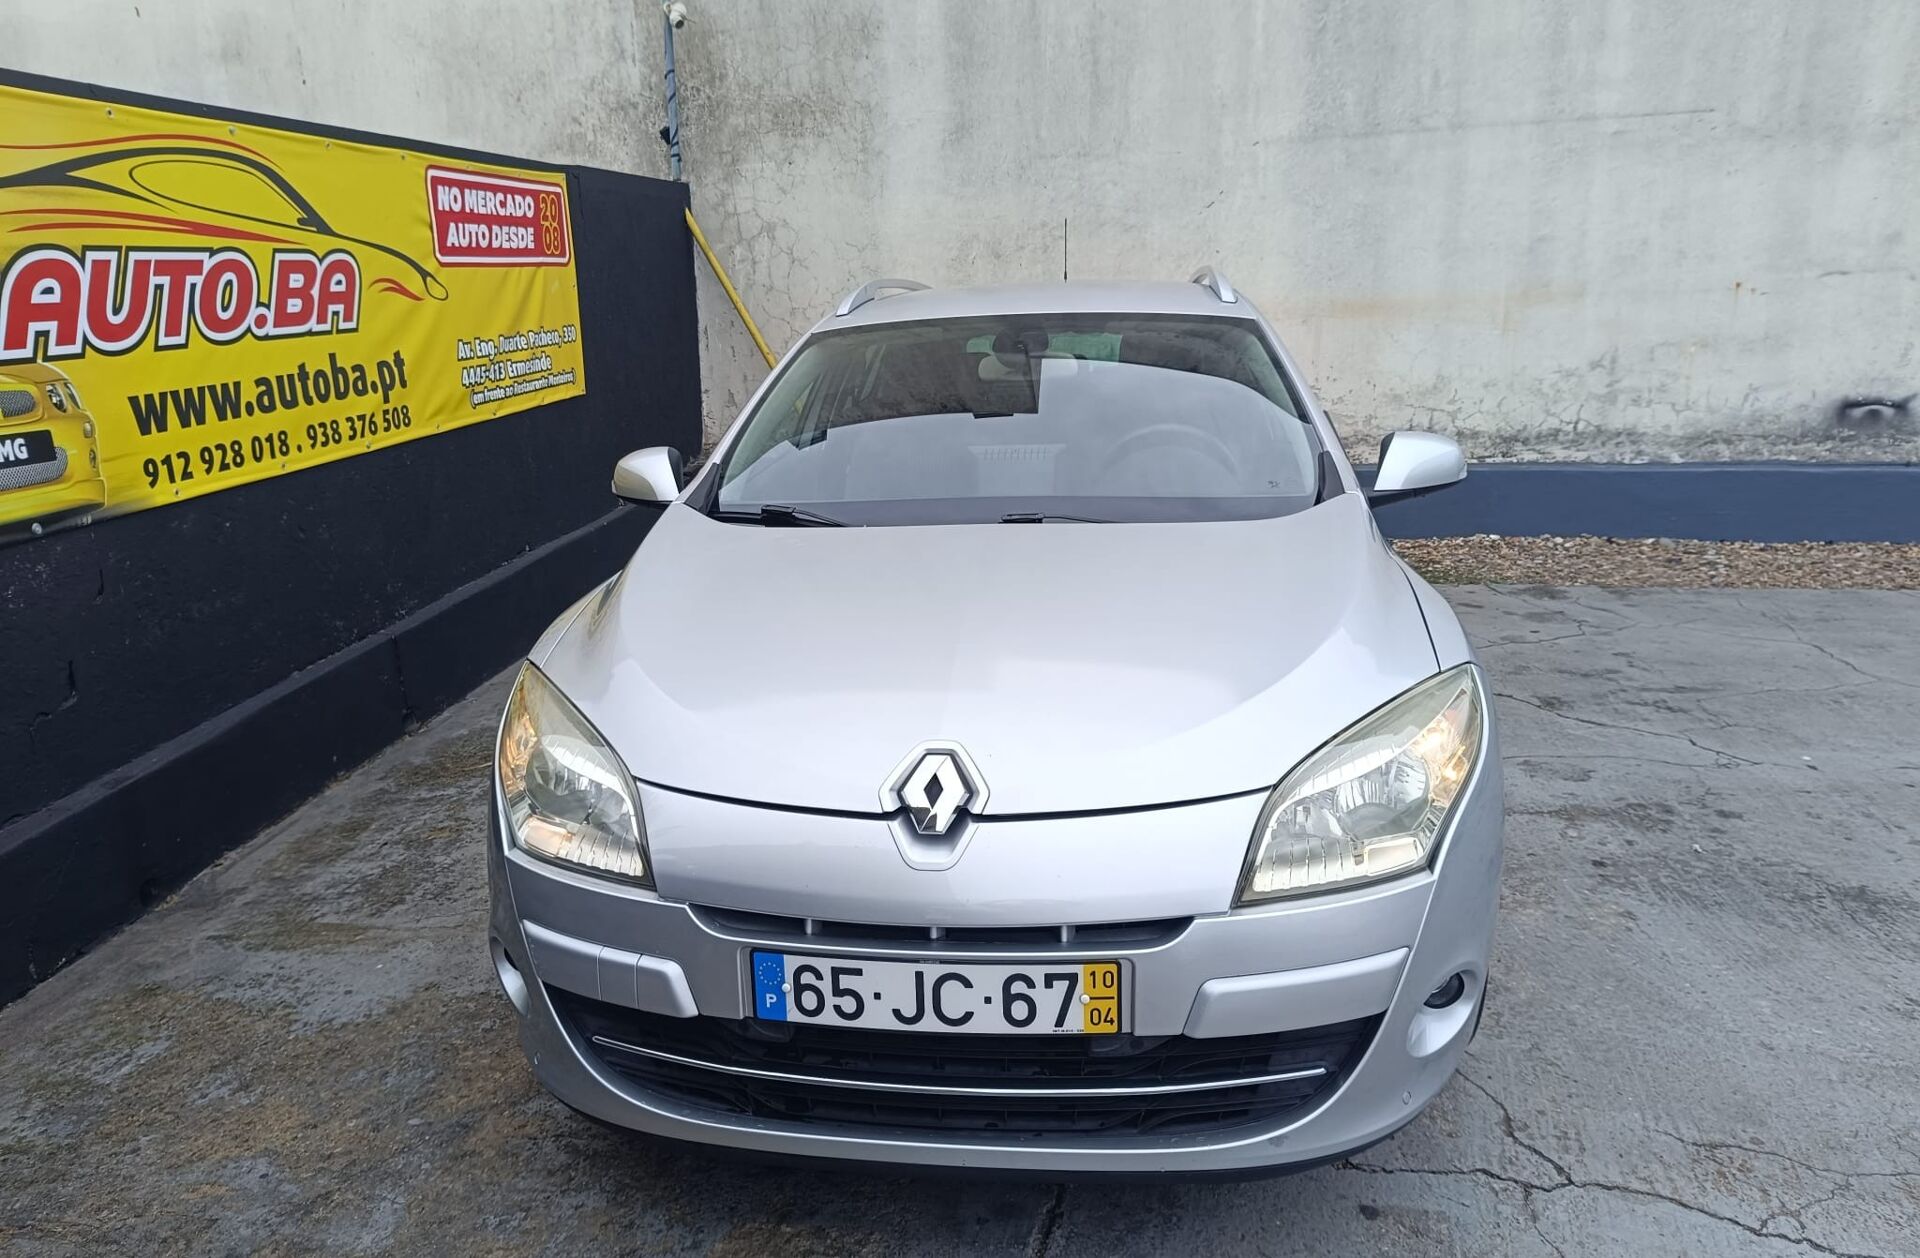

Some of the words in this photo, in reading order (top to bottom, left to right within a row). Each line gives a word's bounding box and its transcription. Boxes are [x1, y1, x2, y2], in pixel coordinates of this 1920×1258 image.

[437, 185, 462, 212] NO
[464, 188, 535, 218] MERCADO
[540, 193, 559, 225] 20
[446, 222, 490, 248] AUTO
[491, 225, 535, 249] DESDE
[543, 223, 560, 254] 08
[1, 248, 359, 362] AUTO.BA
[458, 340, 474, 360] Av.
[475, 338, 498, 360] Eng.
[499, 332, 528, 353] Duarte
[528, 327, 562, 348] Pacheco,
[462, 365, 505, 387] 4445-413
[507, 352, 552, 378] Ermesinde
[127, 349, 408, 437] www.autoba.pt
[143, 451, 194, 488] 912
[199, 440, 245, 475] 928
[251, 430, 290, 463] 018
[306, 419, 342, 450] 938
[348, 412, 378, 441] 376
[382, 405, 411, 432] 508
[1090, 971, 1114, 989] 10
[766, 994, 777, 1008] P
[1090, 1007, 1115, 1026] 04
